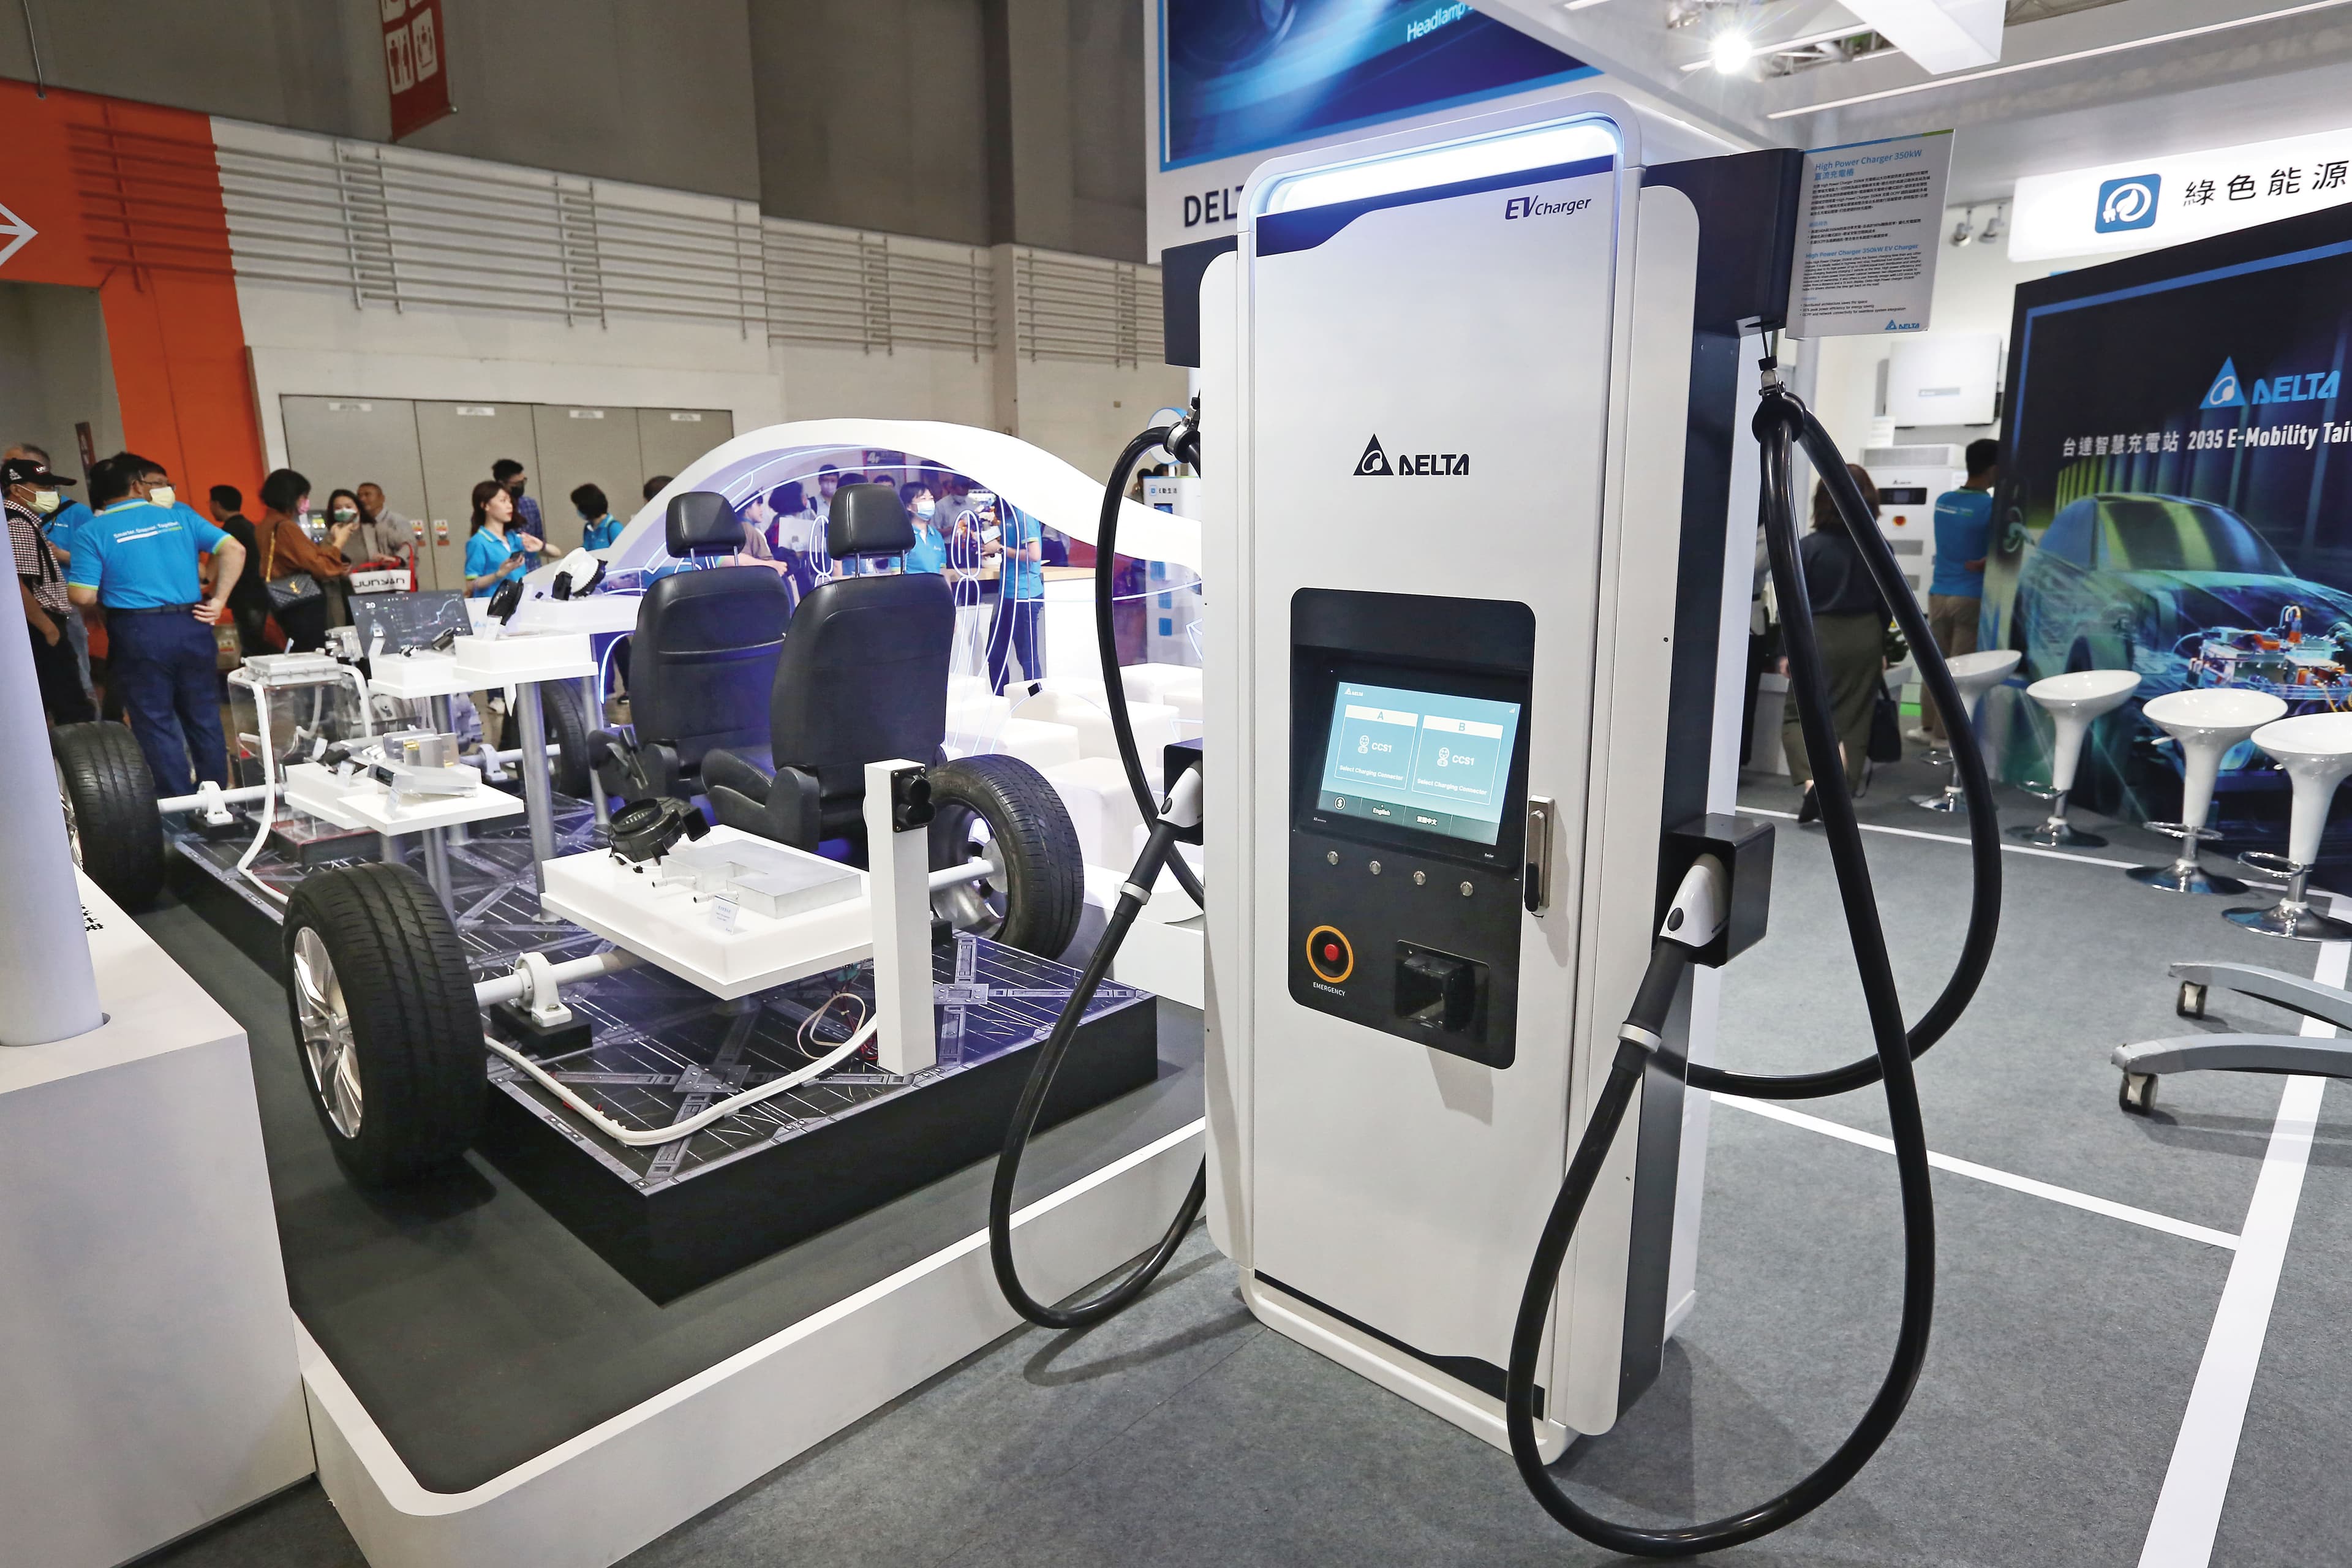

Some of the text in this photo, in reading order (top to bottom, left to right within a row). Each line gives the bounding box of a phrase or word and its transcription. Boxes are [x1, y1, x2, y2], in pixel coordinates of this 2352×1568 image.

[1407, 2, 1466, 42] Headlamp
[1815, 149, 1922, 172] High Power Charger 350kW
[2184, 160, 2349, 206] 綠色能源
[1505, 195, 1591, 220] EV Charger
[2252, 370, 2340, 404] DELTA
[2063, 421, 2352, 457] 台達智慧充電站 2035 E-Mobility Tai
[1399, 454, 1469, 475] DELTA
[1377, 711, 1384, 720] A
[1459, 723, 1466, 731] B
[1371, 742, 1392, 753] CCS1
[1452, 755, 1475, 766] CCS1
[1339, 764, 1403, 781] Select Charging Connector
[1417, 778, 1487, 796] Select Charging Connector
[1373, 807, 1391, 816] English
[1313, 982, 1346, 997] EMERGENCY
